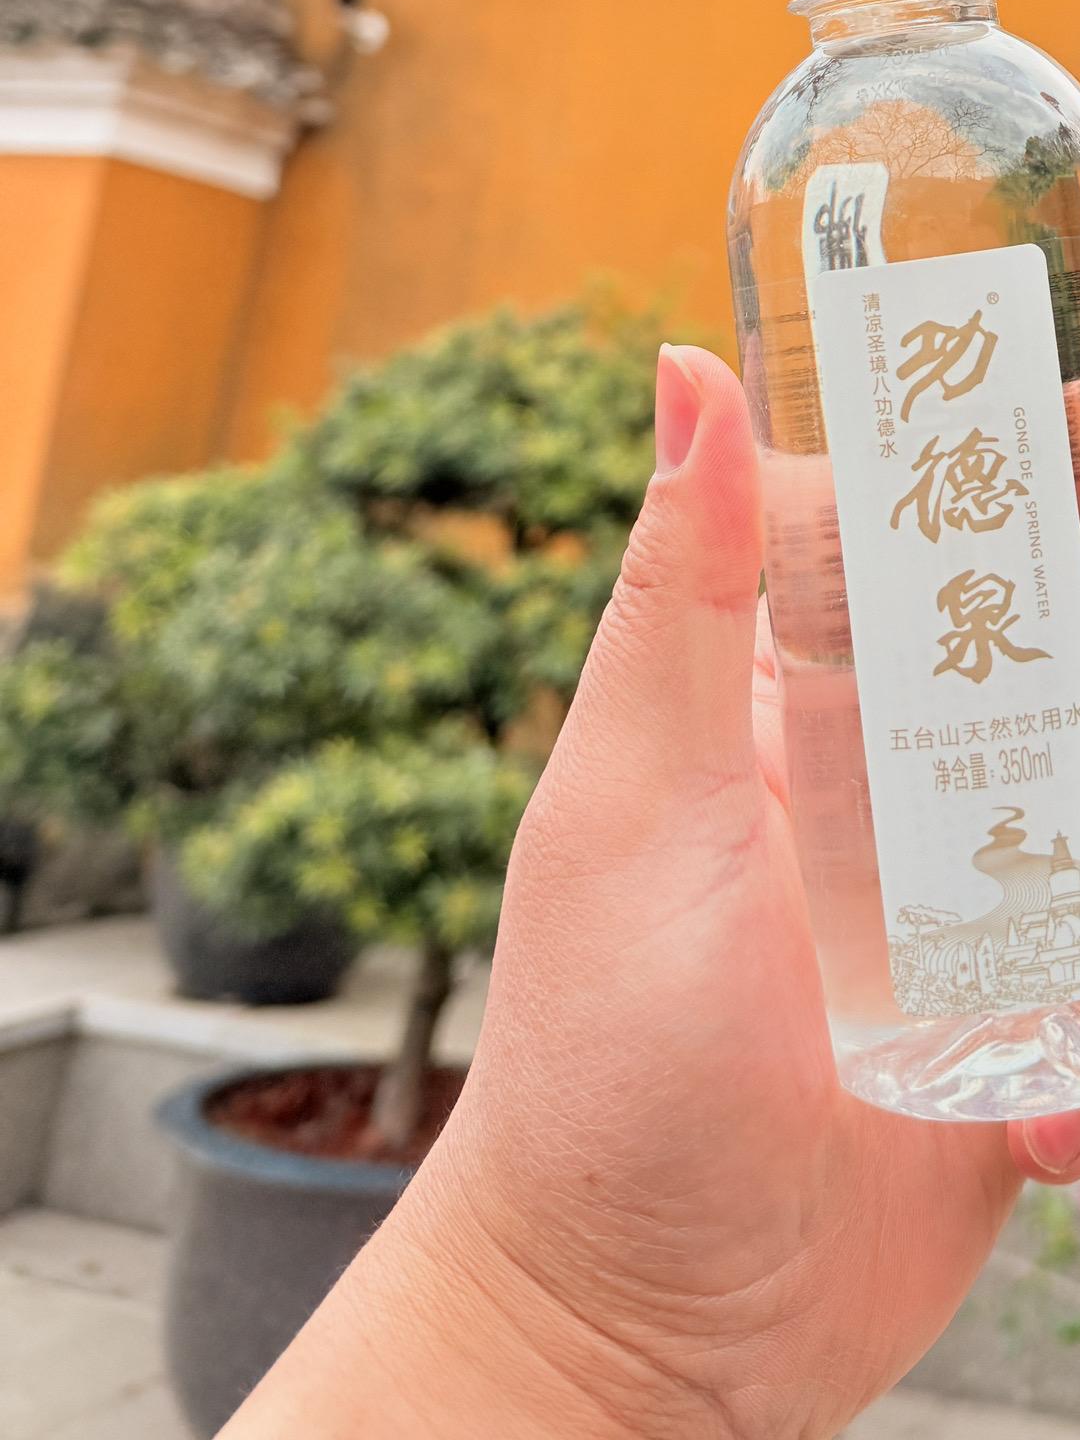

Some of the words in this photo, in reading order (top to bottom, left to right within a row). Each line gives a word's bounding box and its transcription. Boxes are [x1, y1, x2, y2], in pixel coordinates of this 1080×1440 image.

[863, 293, 898, 458] 清凉圣境八功德水
[1013, 407, 1030, 454] GONG
[890, 309, 1054, 684] 功德泉
[1020, 460, 1033, 480] DE
[1025, 501, 1043, 559] SPRING
[1033, 565, 1050, 619] WATER
